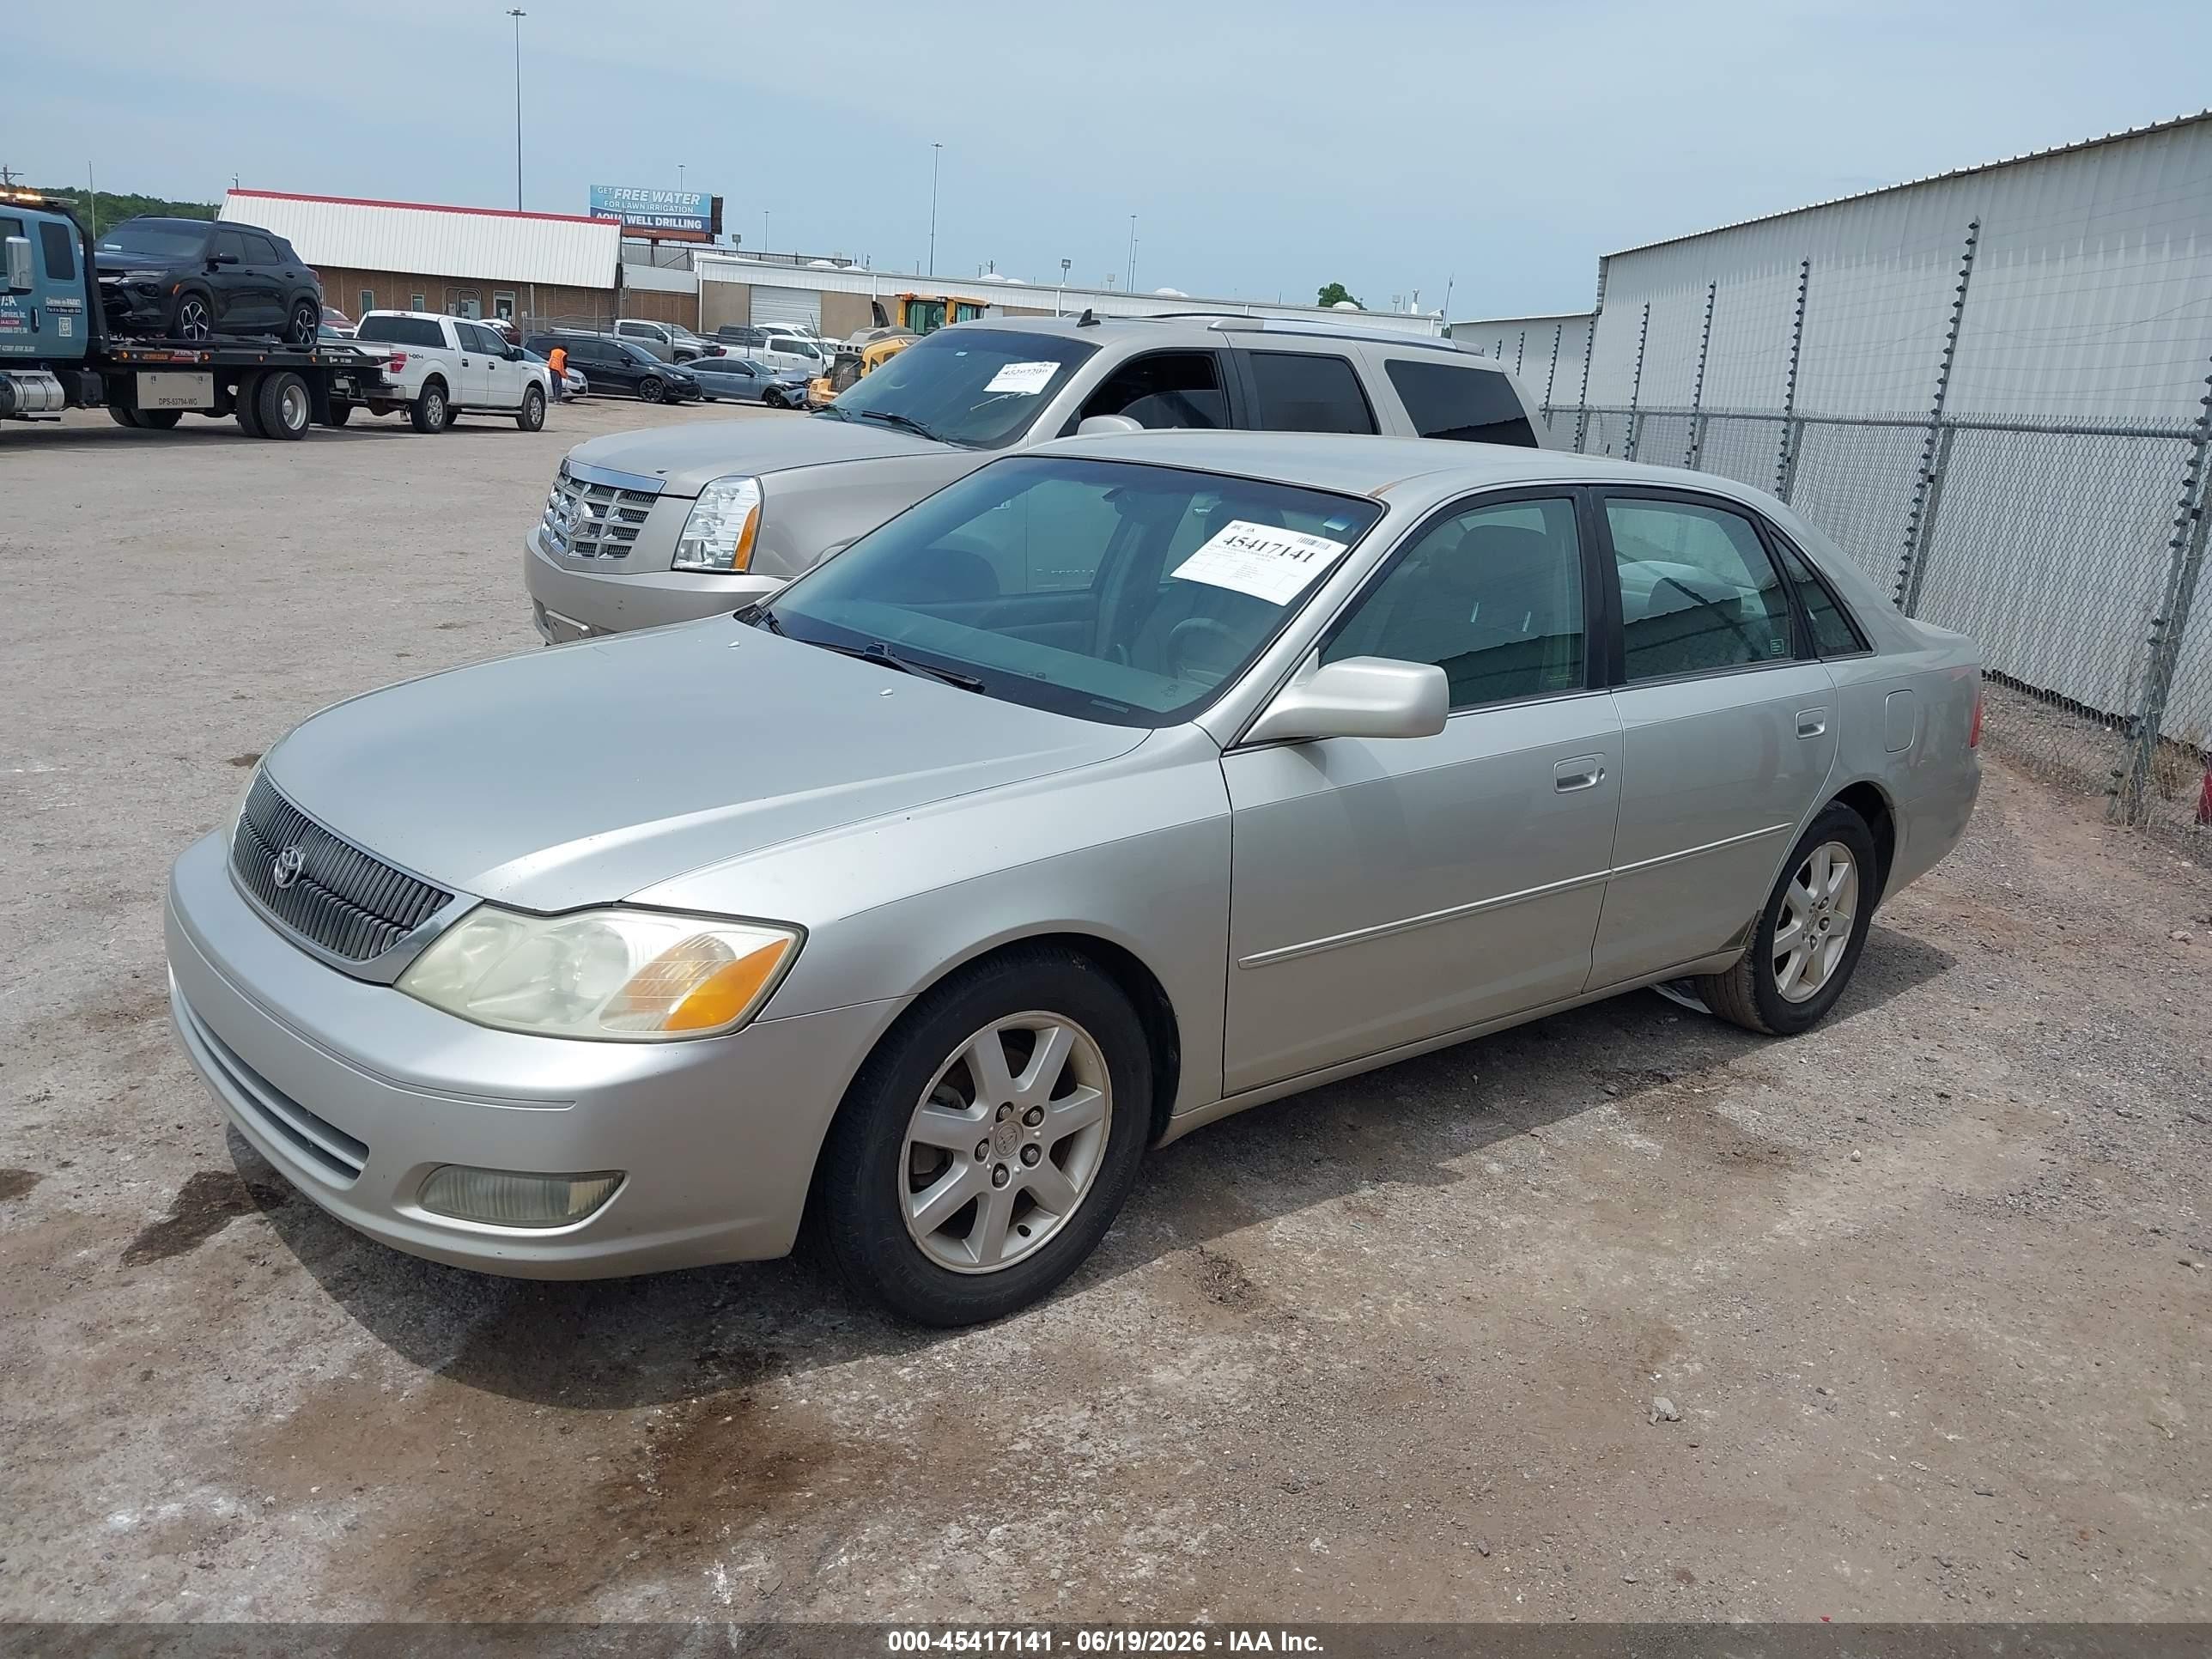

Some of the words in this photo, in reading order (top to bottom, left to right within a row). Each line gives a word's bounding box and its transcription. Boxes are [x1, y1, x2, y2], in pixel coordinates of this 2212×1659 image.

[598, 186, 613, 195] GET
[614, 188, 649, 201] FREE
[652, 191, 701, 205] WATER
[647, 204, 694, 214] IRRIGATION
[627, 215, 653, 226] WELL
[655, 217, 702, 229] DRILLING
[1223, 535, 1316, 563] 45417141
